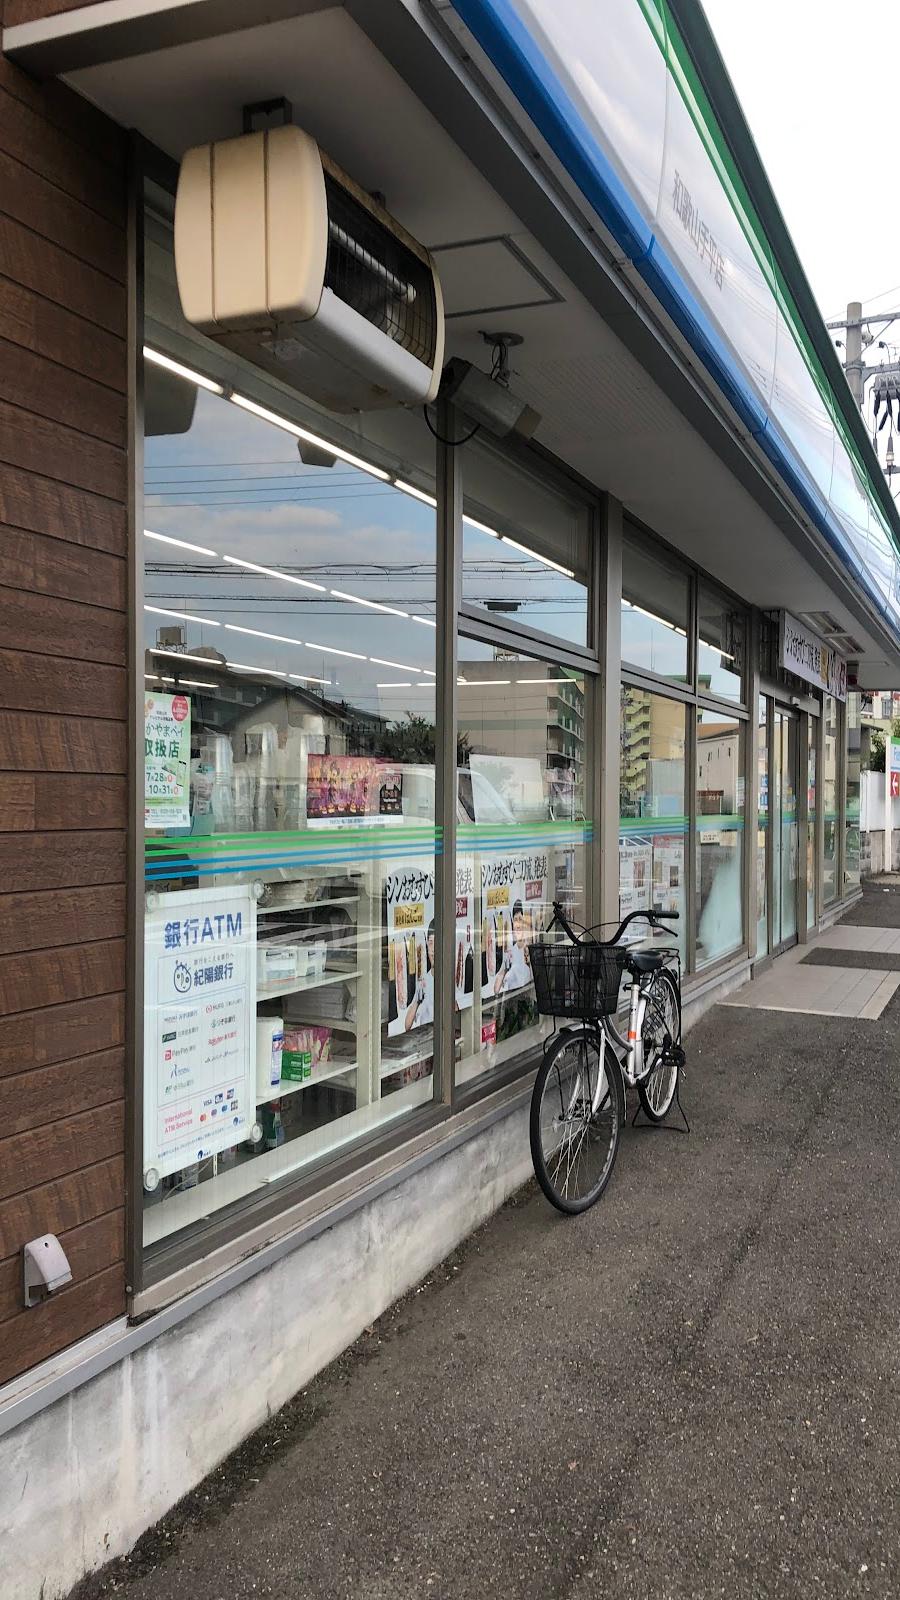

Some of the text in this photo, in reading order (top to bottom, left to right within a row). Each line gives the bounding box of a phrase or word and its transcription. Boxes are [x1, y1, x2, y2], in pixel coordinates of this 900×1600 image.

[165, 912, 242, 950] 銀行ATM
[194, 962, 234, 987] 紀陽銀行
